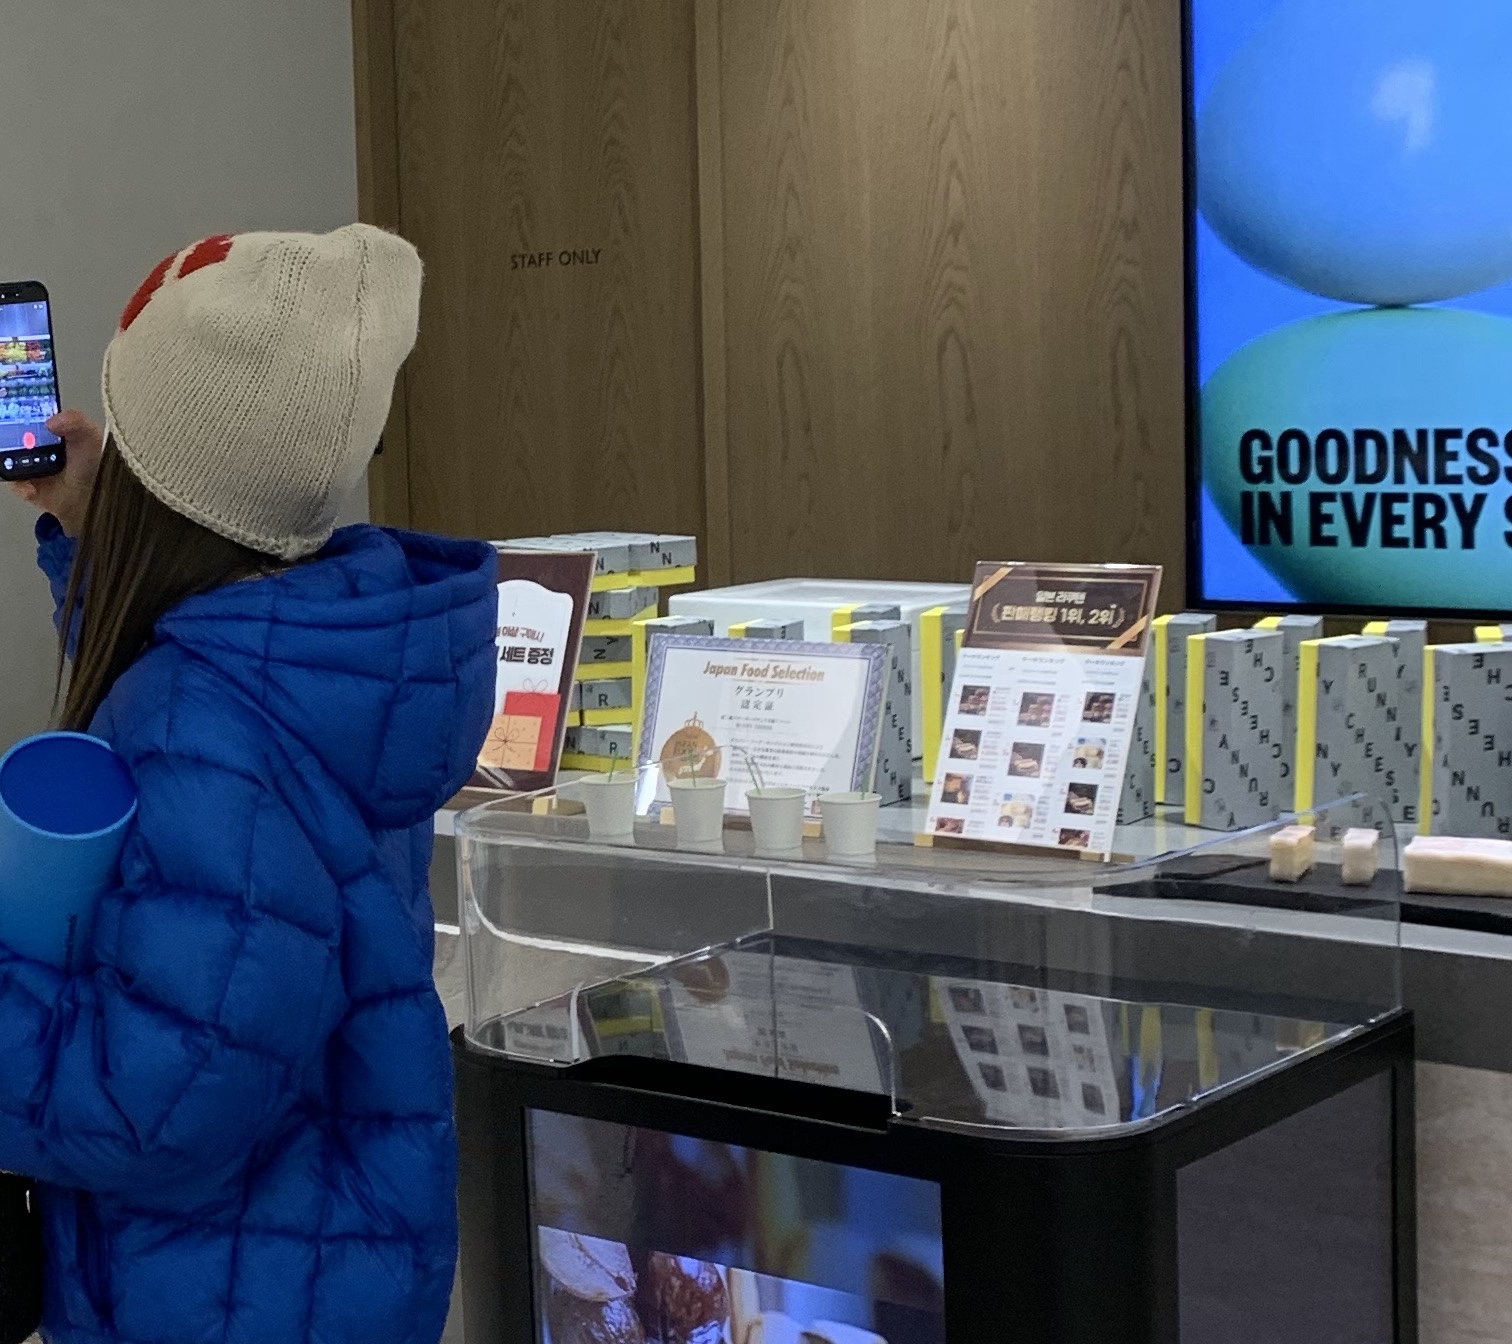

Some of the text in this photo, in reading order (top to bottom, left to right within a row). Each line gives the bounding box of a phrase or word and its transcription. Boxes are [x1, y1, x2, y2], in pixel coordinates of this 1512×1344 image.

[510, 248, 602, 271] STAFF ONLY
[1240, 427, 1512, 486] GOODNES
[1240, 490, 1294, 546] IN
[1308, 491, 1489, 550] EVERY
[500, 645, 554, 665] 세트 증정
[703, 660, 825, 682] Japan Food Selection
